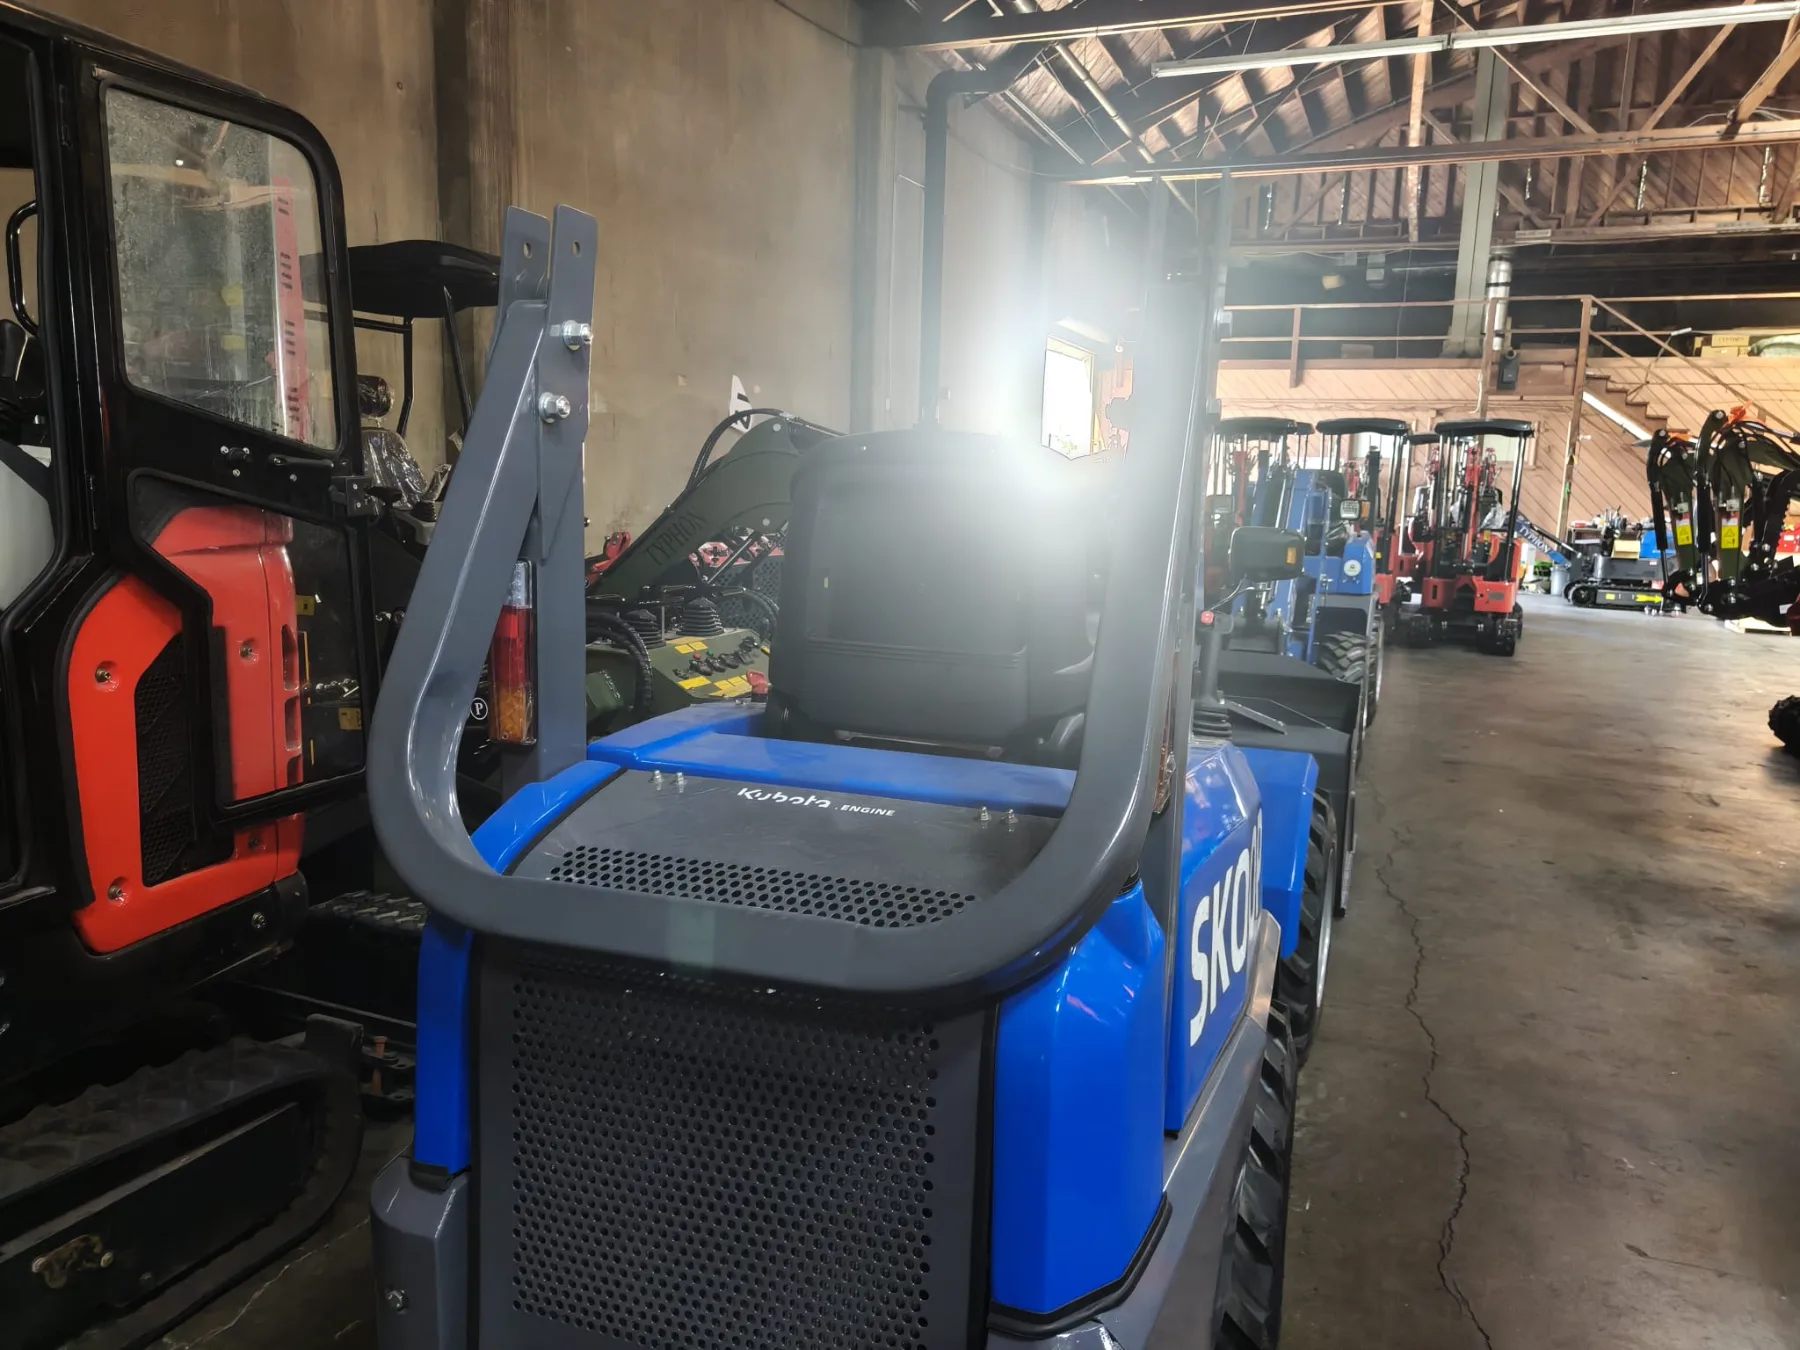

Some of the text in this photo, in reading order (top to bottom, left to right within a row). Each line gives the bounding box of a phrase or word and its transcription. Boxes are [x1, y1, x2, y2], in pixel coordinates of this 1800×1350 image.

[644, 511, 708, 566] TYPHON
[473, 702, 484, 716] P
[737, 787, 832, 809] Kubota
